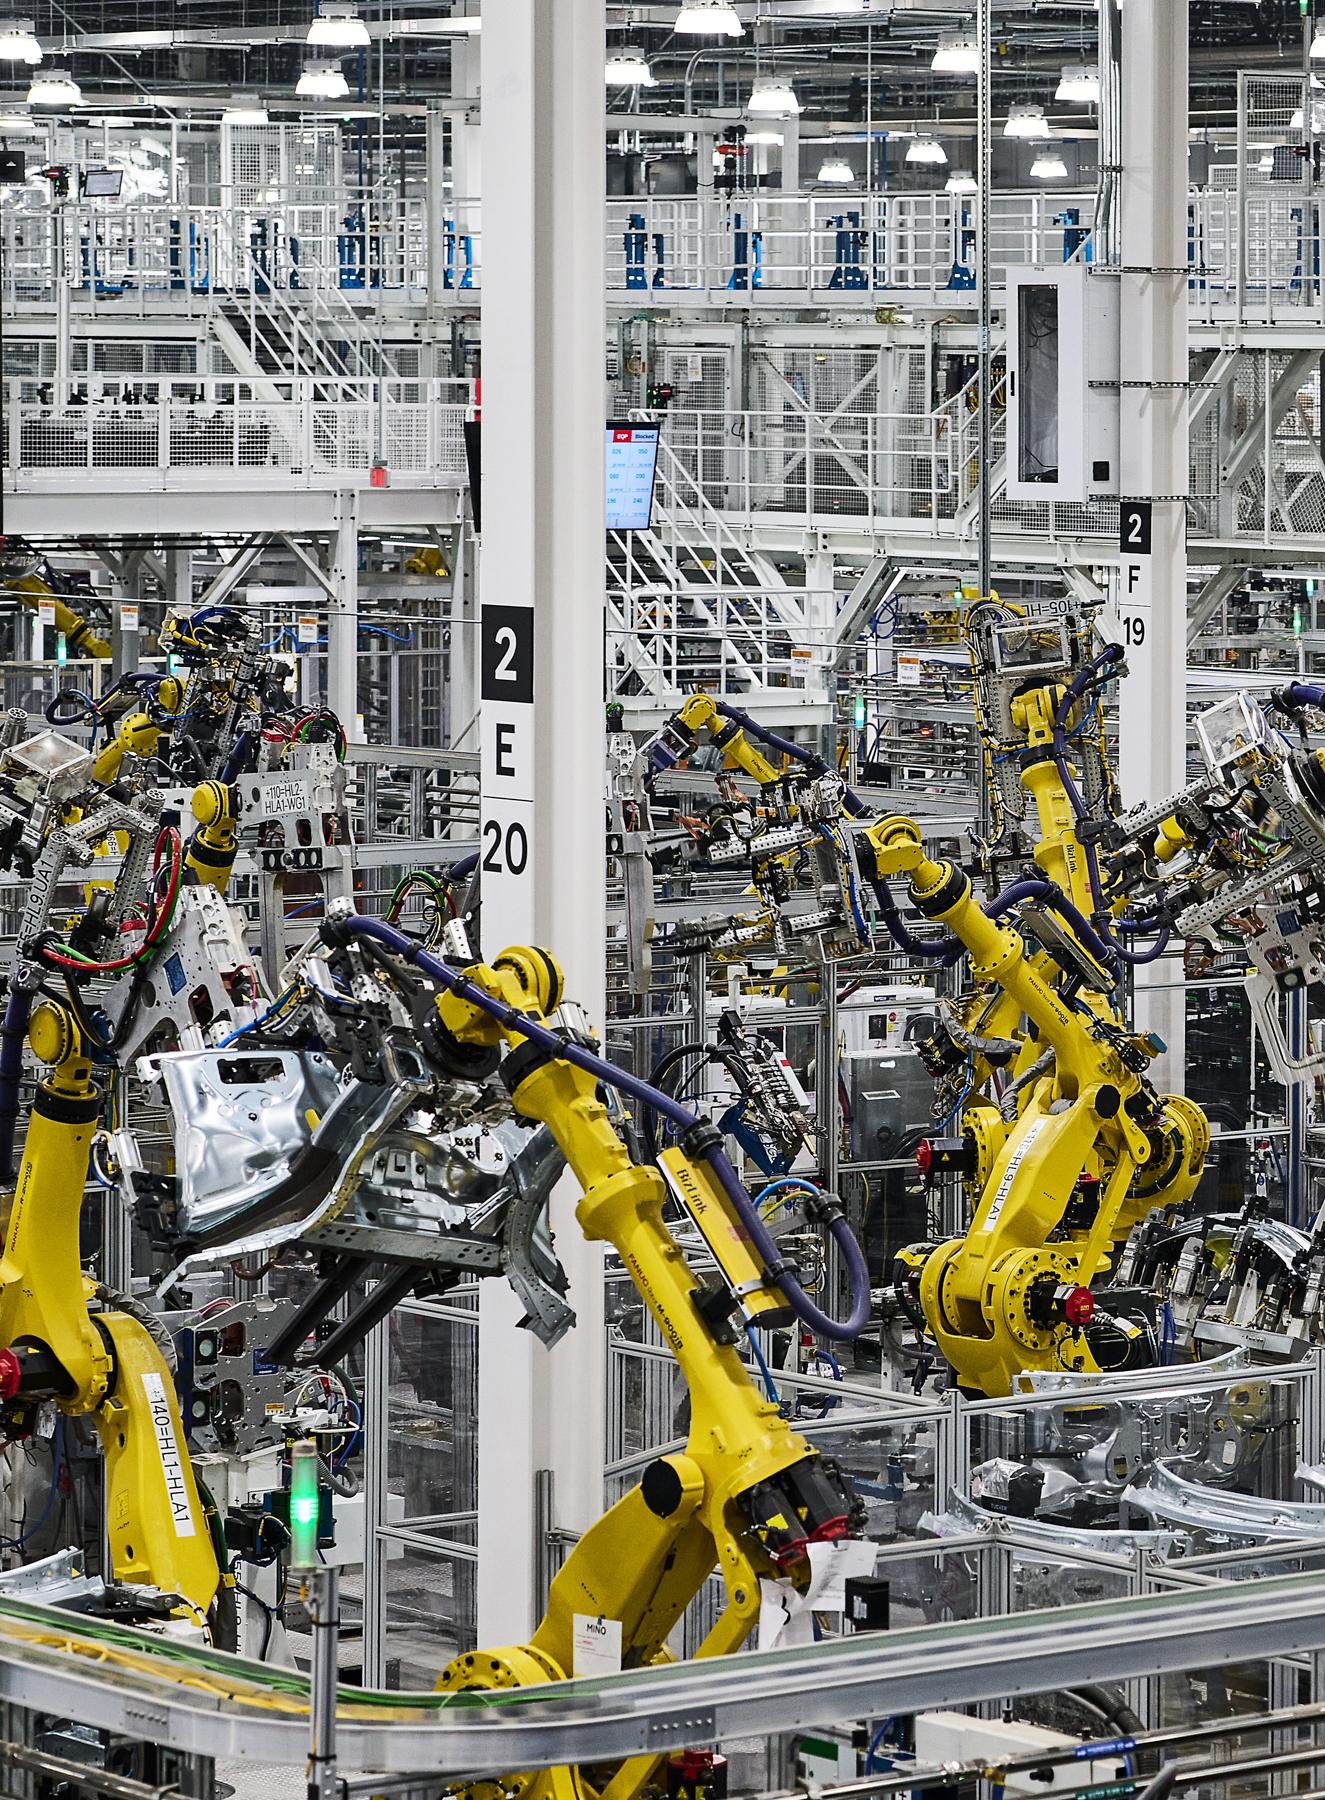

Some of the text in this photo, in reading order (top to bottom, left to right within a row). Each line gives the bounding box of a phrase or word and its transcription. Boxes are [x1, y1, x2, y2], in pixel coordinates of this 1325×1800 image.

[1128, 514, 1142, 543] 2
[1128, 565, 1141, 593] F
[1123, 617, 1145, 646] 19
[494, 626, 517, 681] 2
[496, 723, 515, 777] E
[265, 796, 306, 813] HLA1-WG1
[482, 819, 528, 876] 20
[1066, 844, 1077, 873] BizLink
[1028, 977, 1043, 994] FANUC
[1050, 1001, 1069, 1024] M-900iB
[677, 1169, 708, 1215] BizLink
[11, 1222, 19, 1252] FANUC
[628, 1253, 649, 1286] FANUC
[657, 1304, 684, 1350] M-900iB
[587, 1624, 606, 1635] MINO
